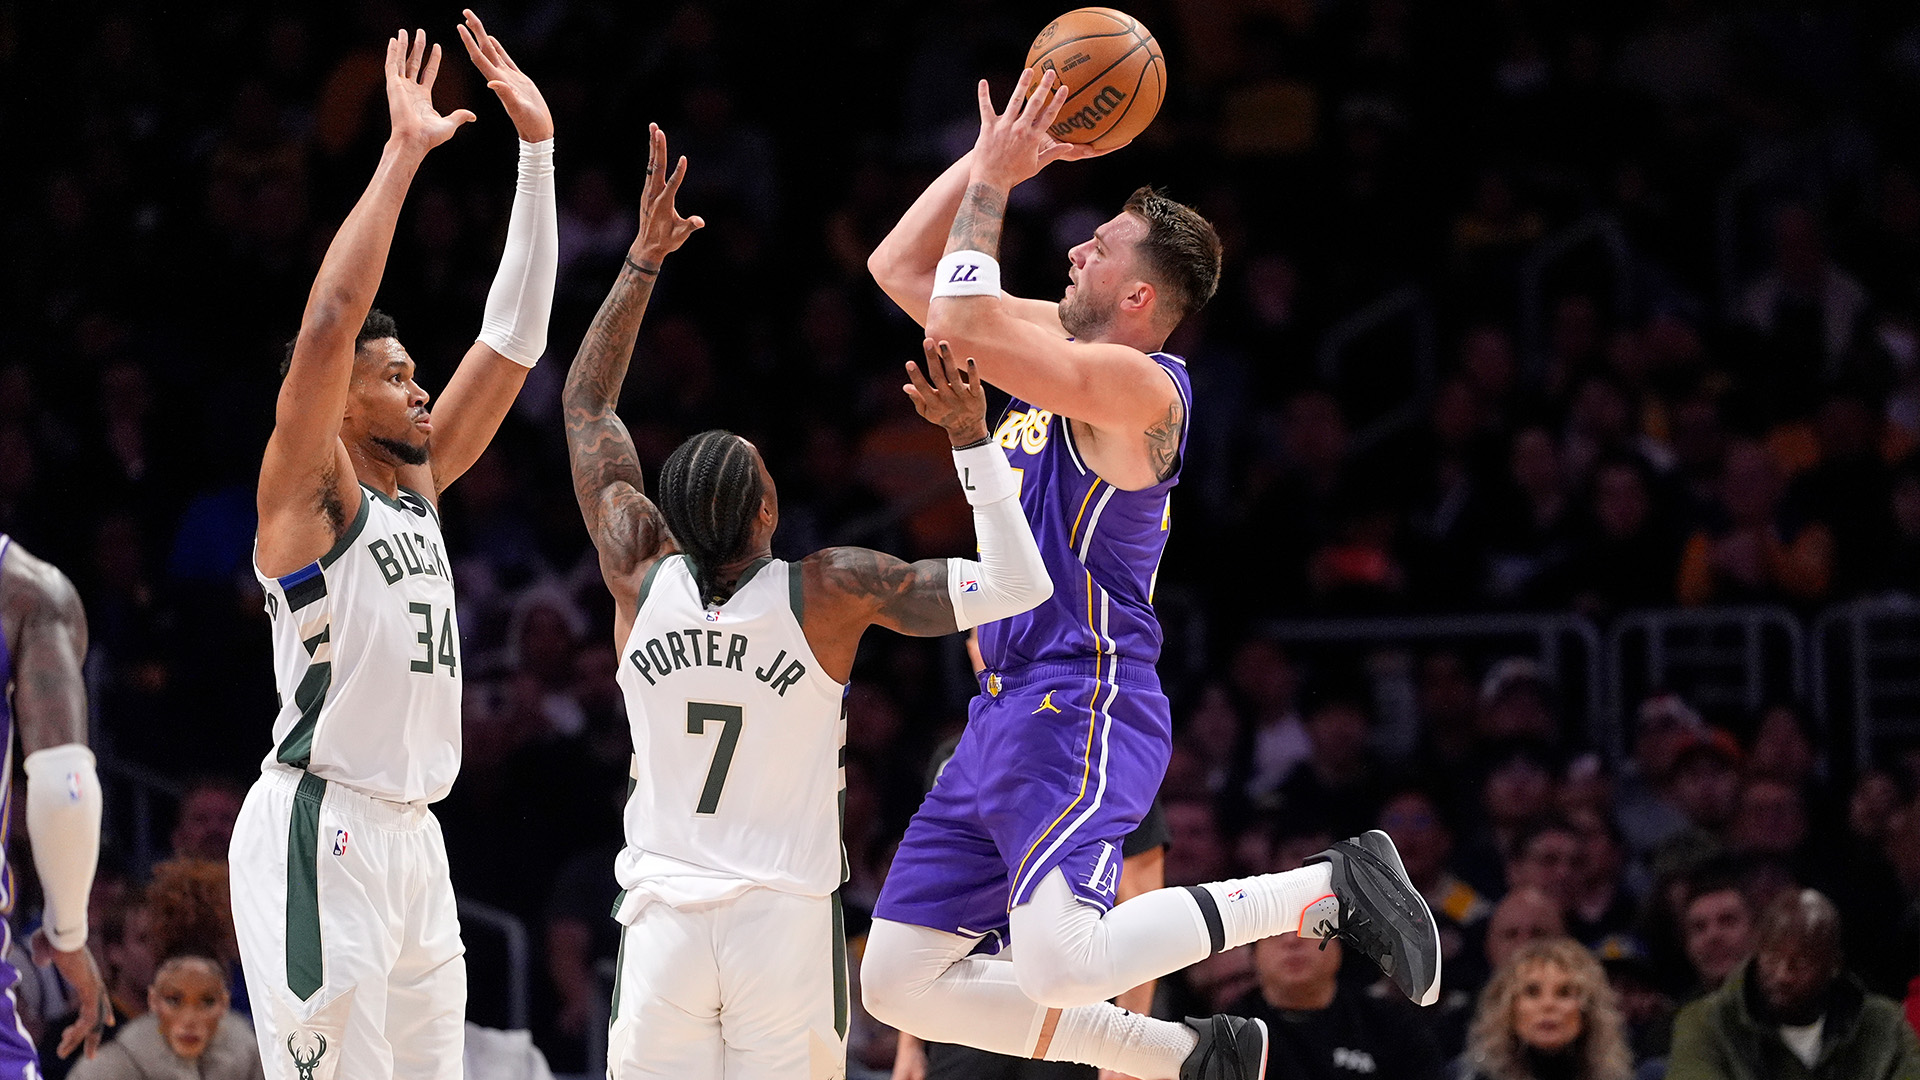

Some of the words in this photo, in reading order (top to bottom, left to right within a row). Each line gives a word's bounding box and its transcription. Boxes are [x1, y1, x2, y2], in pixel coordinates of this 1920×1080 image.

[1049, 85, 1127, 137] Wilson
[367, 531, 455, 586] BUCK
[408, 601, 456, 678] 34
[629, 629, 748, 686] PORTER
[755, 649, 806, 697] JR
[686, 700, 744, 816] 7
